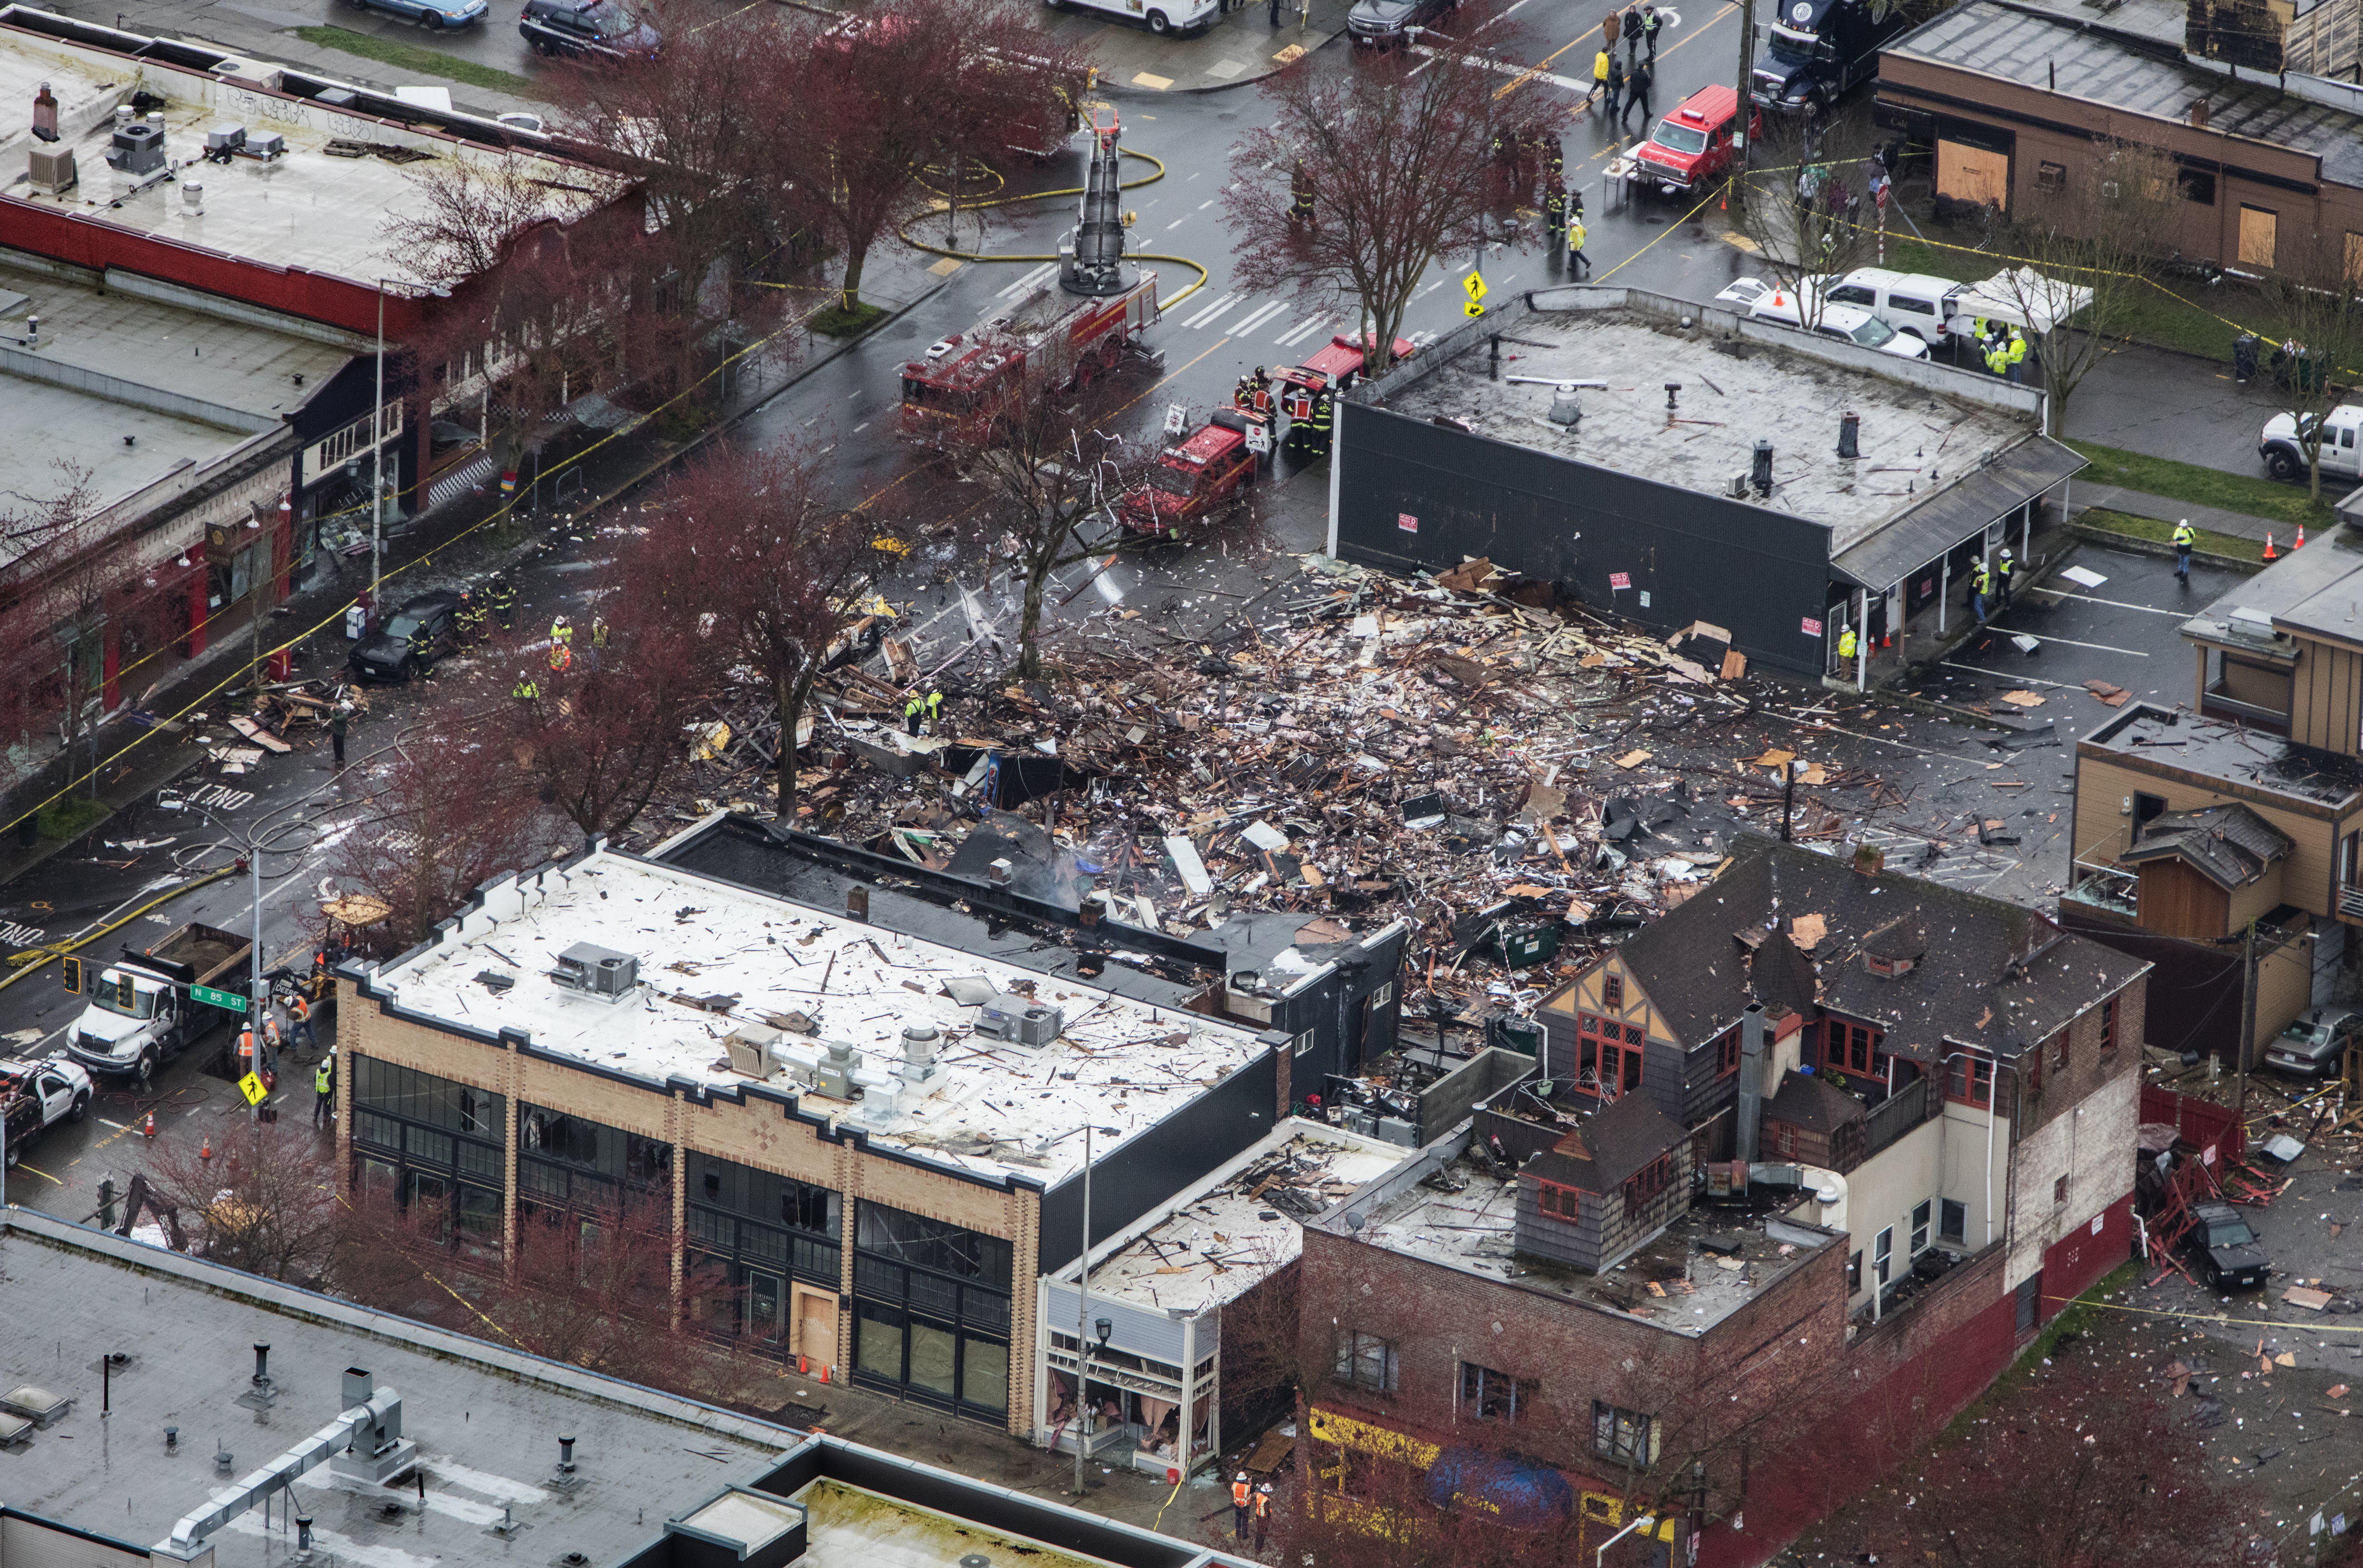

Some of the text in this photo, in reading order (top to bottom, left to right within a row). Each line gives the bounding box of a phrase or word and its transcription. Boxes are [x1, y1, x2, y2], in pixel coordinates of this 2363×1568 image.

[195, 988, 242, 1006] N 85 ST
[275, 984, 299, 997] DEERE
